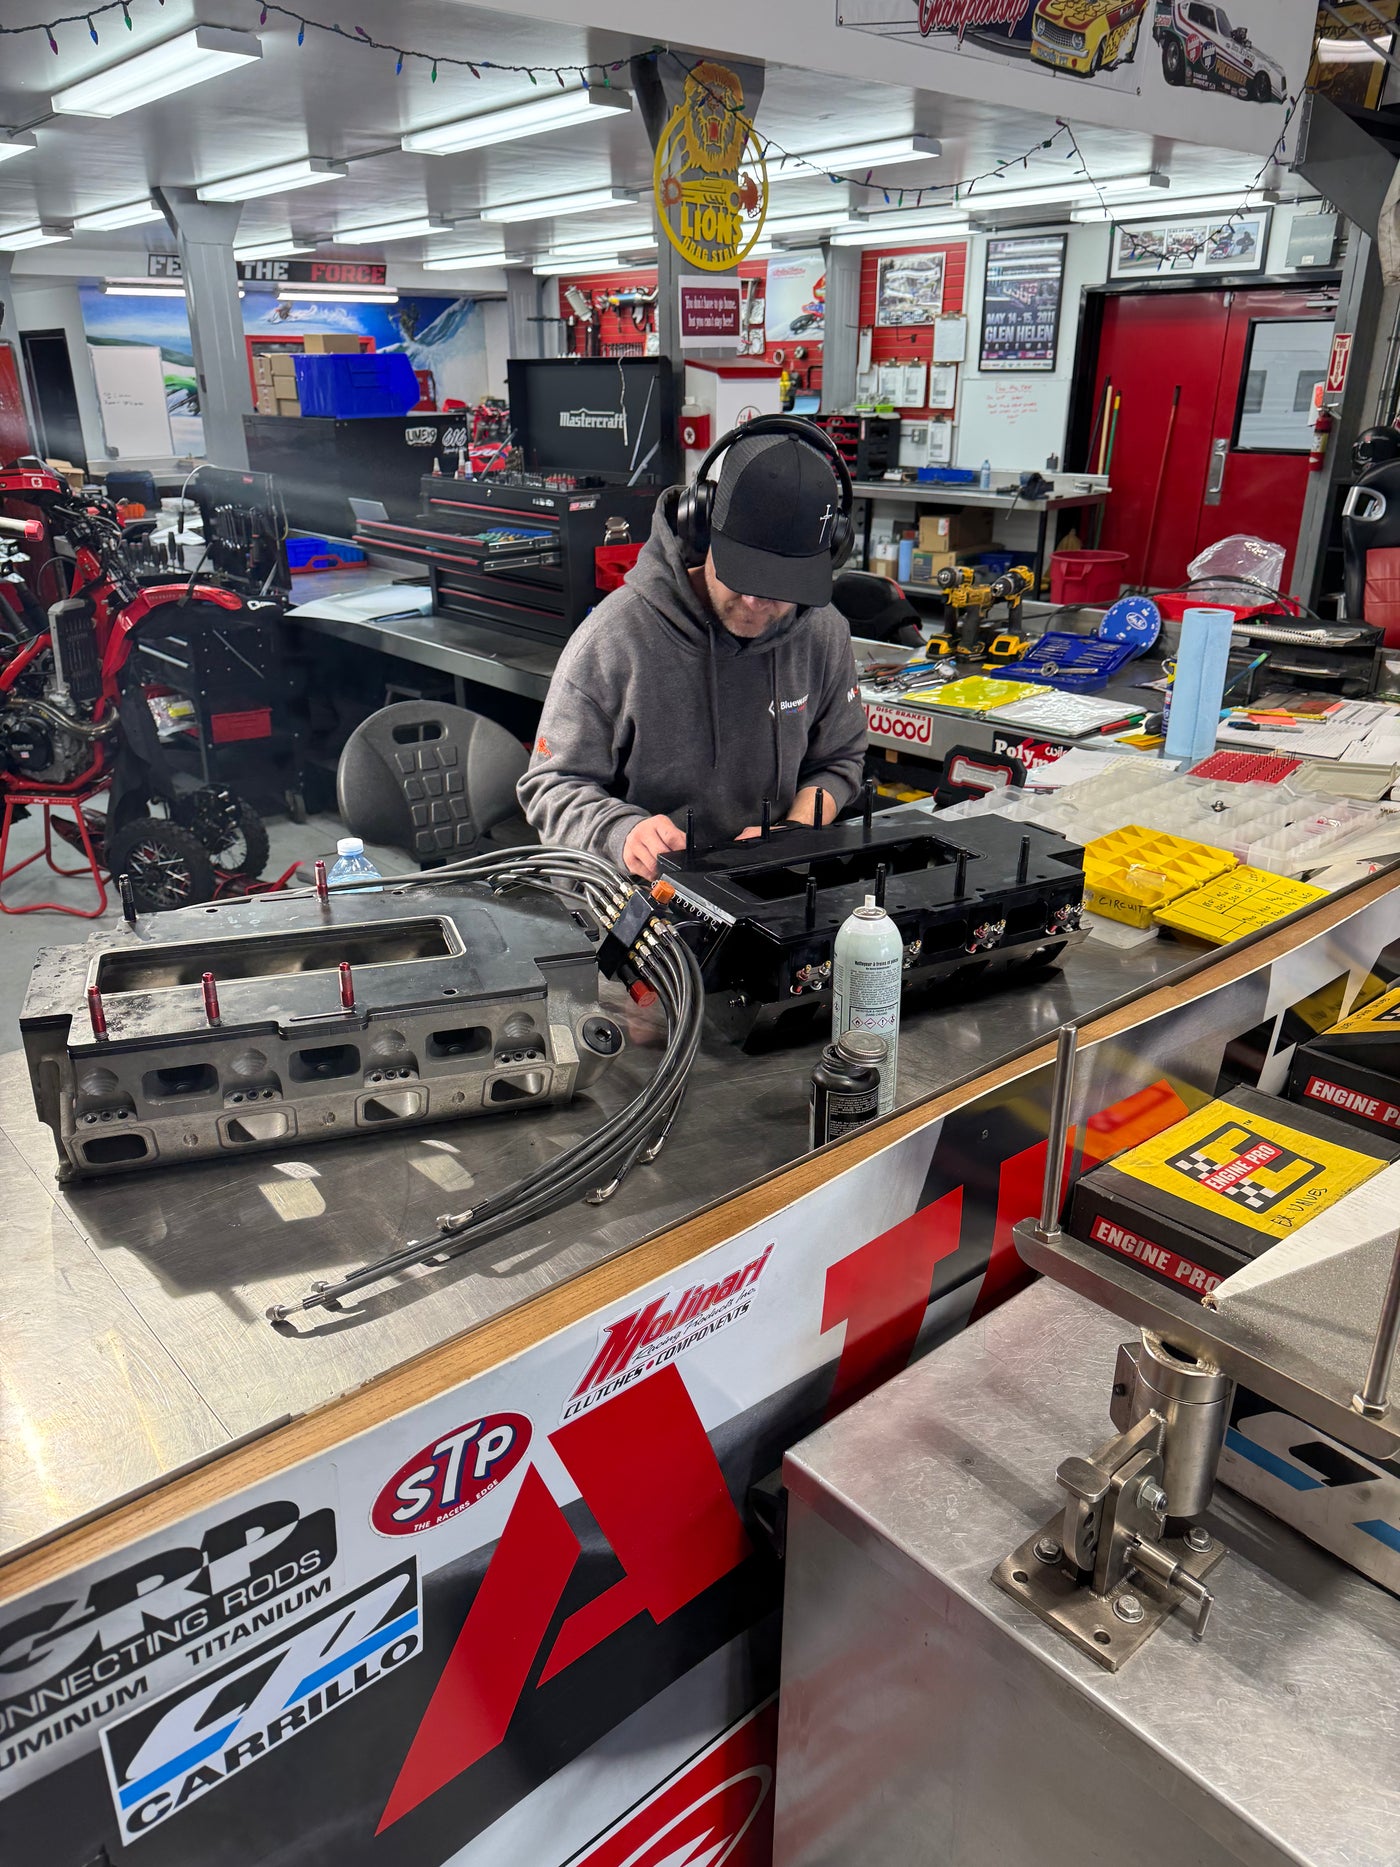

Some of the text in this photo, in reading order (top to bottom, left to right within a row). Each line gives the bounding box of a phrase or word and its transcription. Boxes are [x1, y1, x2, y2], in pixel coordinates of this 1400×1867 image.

[681, 204, 743, 245] LIONS
[150, 256, 385, 284] FE THE FORCE
[985, 324, 1054, 343] GLEN HELEN
[986, 312, 1006, 325] MAY
[1036, 311, 1056, 323] 2011
[560, 411, 624, 429] Mastercraft
[876, 705, 926, 721] DISC BRAKES
[995, 739, 1035, 768] Poly
[1099, 896, 1148, 913] CIRCUIT
[1310, 1080, 1400, 1126] ENGINE P
[1204, 1145, 1276, 1190] ENGINE PRO
[1096, 1221, 1222, 1292] ENGINE PRO
[568, 1242, 775, 1402] Molinari
[632, 1330, 681, 1364] Racing
[684, 1299, 733, 1335] Products
[563, 1300, 752, 1420] CLUTCHES COMPONENTS
[391, 1418, 517, 1523] STP
[413, 1479, 499, 1532] THE RACERS EDGE
[223, 1548, 321, 1615] RODS
[185, 1576, 332, 1666] TITANIUM
[126, 1633, 419, 1834] CARRILLO
